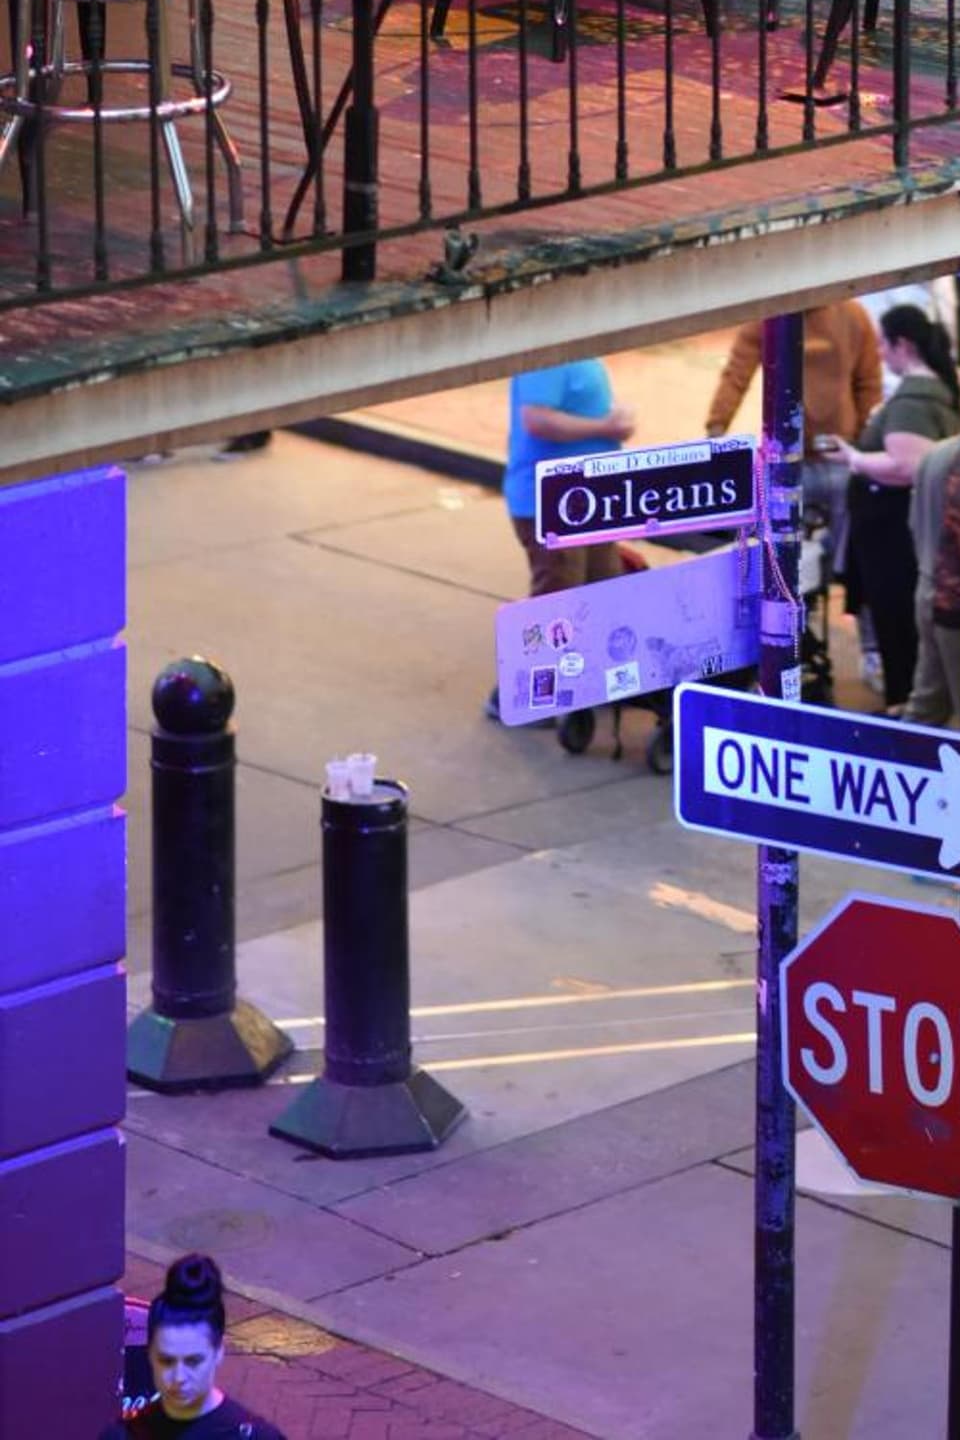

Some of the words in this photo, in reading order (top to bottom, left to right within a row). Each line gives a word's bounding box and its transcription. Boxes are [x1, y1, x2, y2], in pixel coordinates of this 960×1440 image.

[558, 478, 738, 527] Orleans
[716, 738, 812, 805] ONE
[830, 758, 929, 825] WAY
